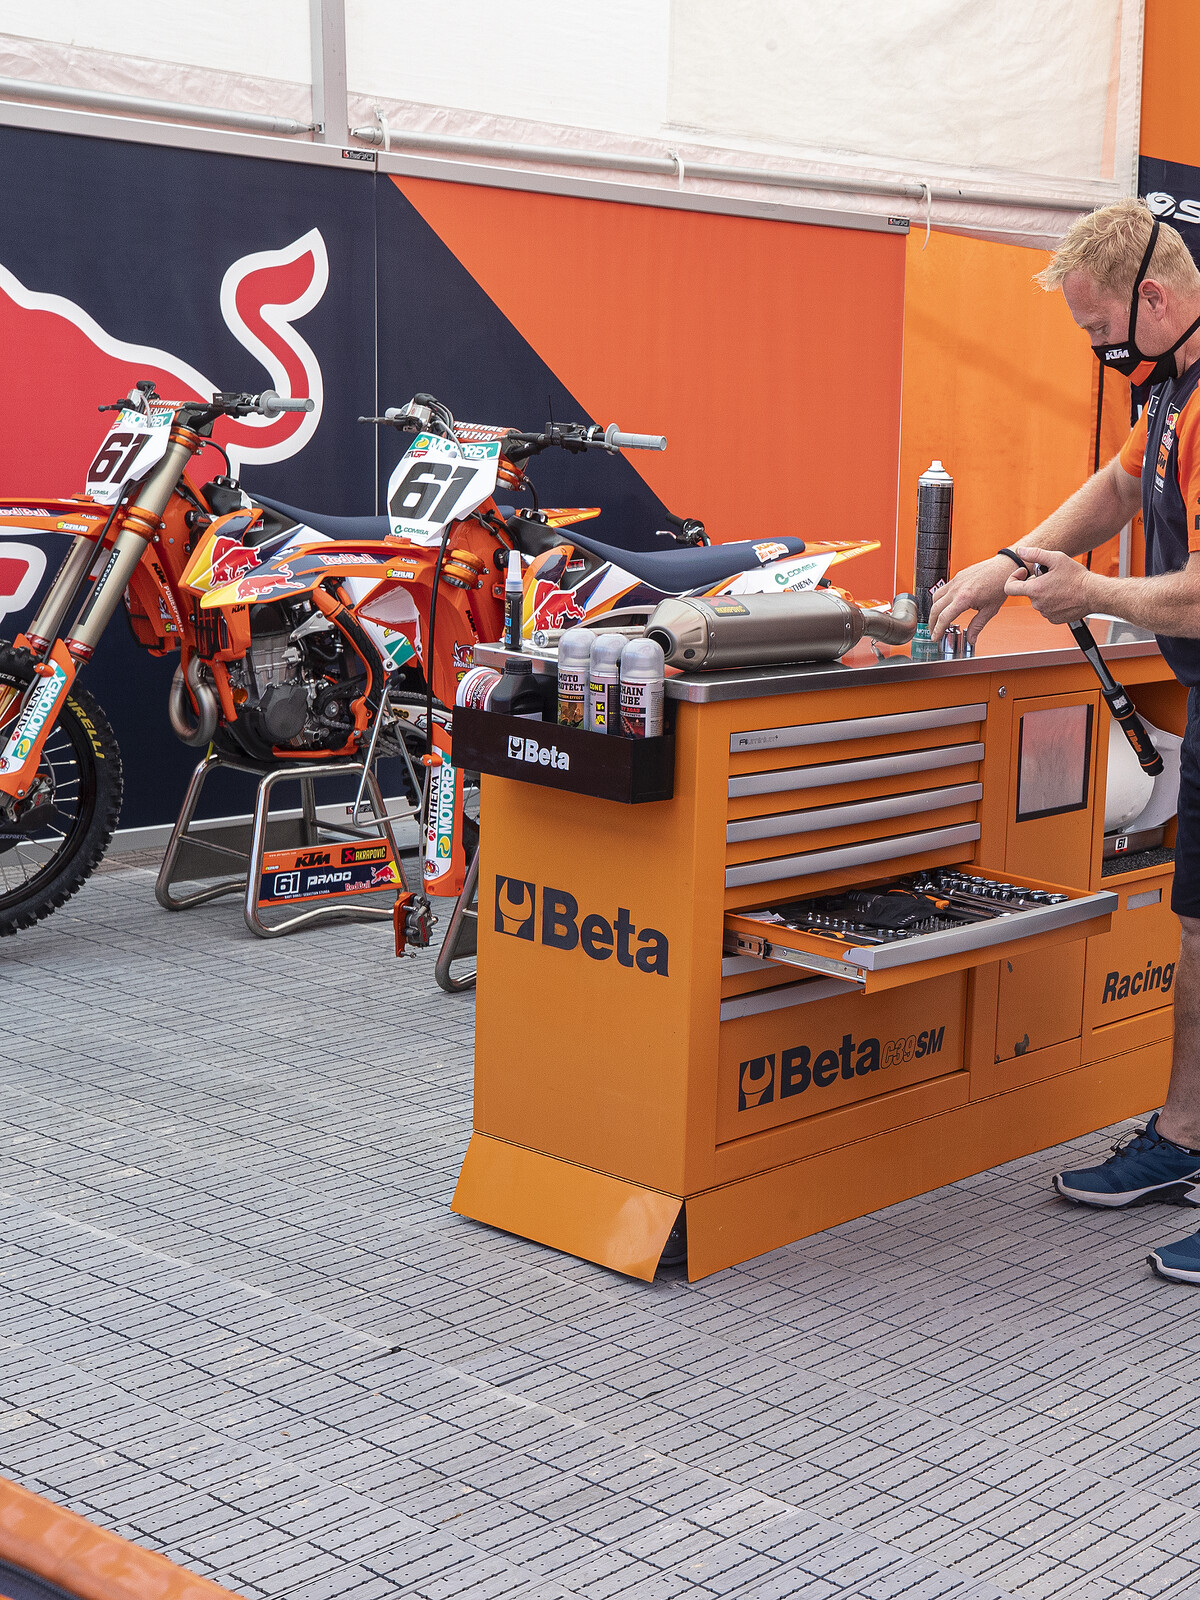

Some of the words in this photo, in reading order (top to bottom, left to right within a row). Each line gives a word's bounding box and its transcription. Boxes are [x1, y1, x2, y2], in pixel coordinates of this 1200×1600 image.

[1105, 349, 1129, 360] KTM
[88, 433, 153, 485] 61
[389, 462, 479, 523] 61
[231, 604, 246, 614] KTM
[17, 684, 46, 731] ATHENA
[24, 673, 67, 739] MOTOREX
[525, 738, 570, 771] Beta
[429, 775, 440, 830] ATHENA
[438, 761, 456, 834] MOTOREX
[295, 851, 331, 868] KTM
[1117, 838, 1126, 849] 61
[273, 872, 300, 896] 61
[307, 872, 352, 890] PRADO
[541, 887, 670, 977] Beta
[1102, 959, 1176, 1005] Racing
[781, 1033, 880, 1100] Beta
